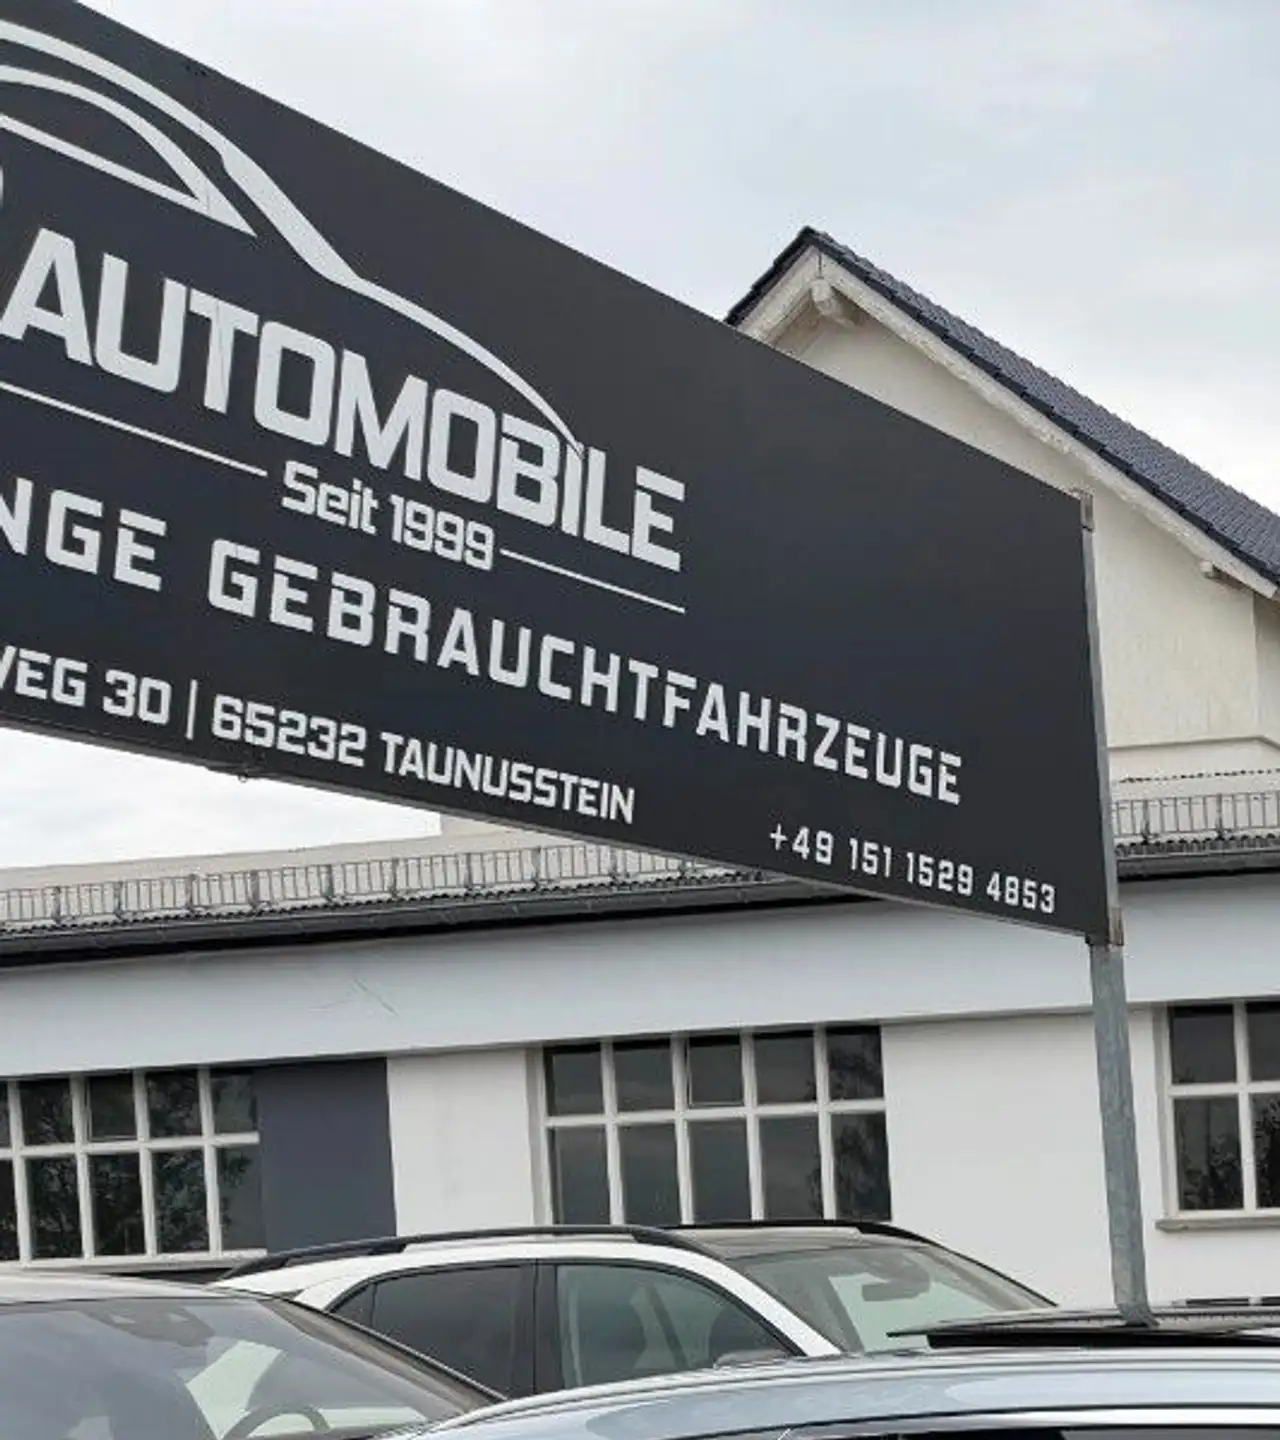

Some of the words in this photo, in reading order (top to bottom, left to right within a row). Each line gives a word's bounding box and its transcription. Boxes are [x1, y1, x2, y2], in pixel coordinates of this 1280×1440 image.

[0, 228, 686, 573] AUTOMOBILE
[281, 460, 379, 536] Seit
[389, 496, 496, 572] 1999
[103, 669, 172, 725] 30
[211, 694, 368, 769] 65232
[380, 732, 636, 825] TAUNUSSTEIN
[207, 538, 962, 806] GEBRAUCHTFAHRZEUGE
[770, 823, 834, 866] +49
[849, 838, 892, 878] 151
[906, 852, 974, 897] 1529
[985, 871, 1056, 915] 4853
